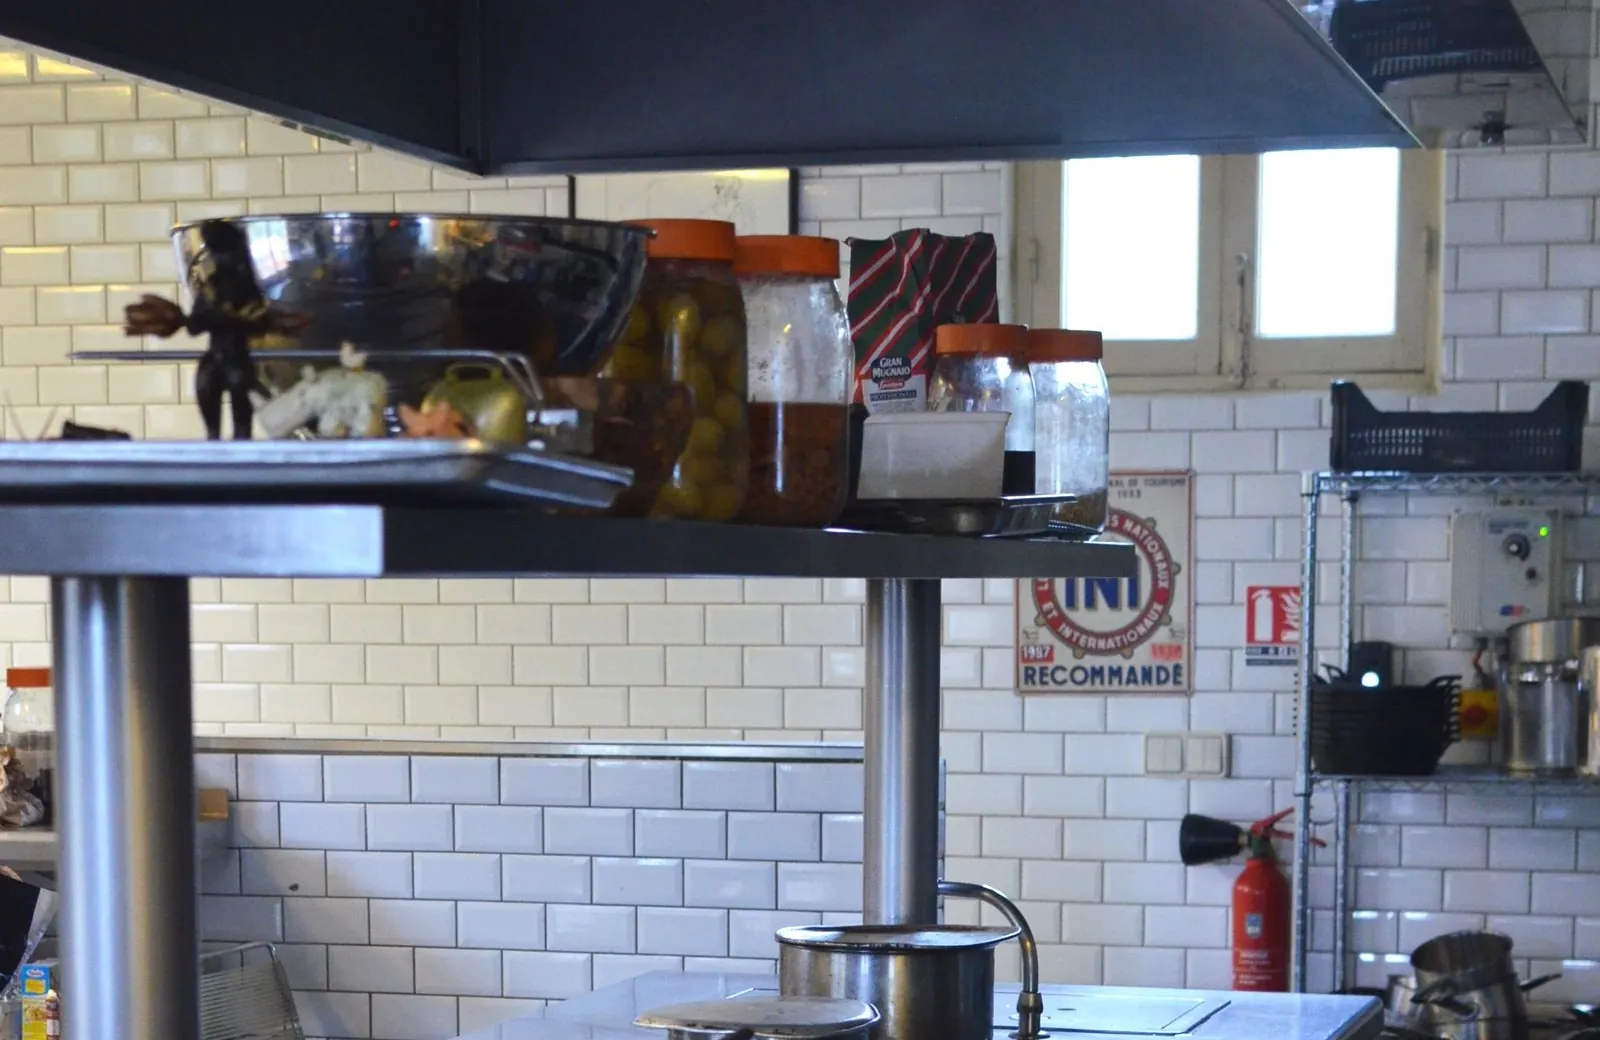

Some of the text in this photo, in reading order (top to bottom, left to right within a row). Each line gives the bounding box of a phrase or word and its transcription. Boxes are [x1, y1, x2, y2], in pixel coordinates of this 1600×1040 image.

[873, 366, 910, 378] MUGNAIO
[880, 357, 902, 367] GRAN
[1122, 518, 1170, 589] NATIONAUX
[1041, 602, 1164, 650] ET INTERNATIONAUX
